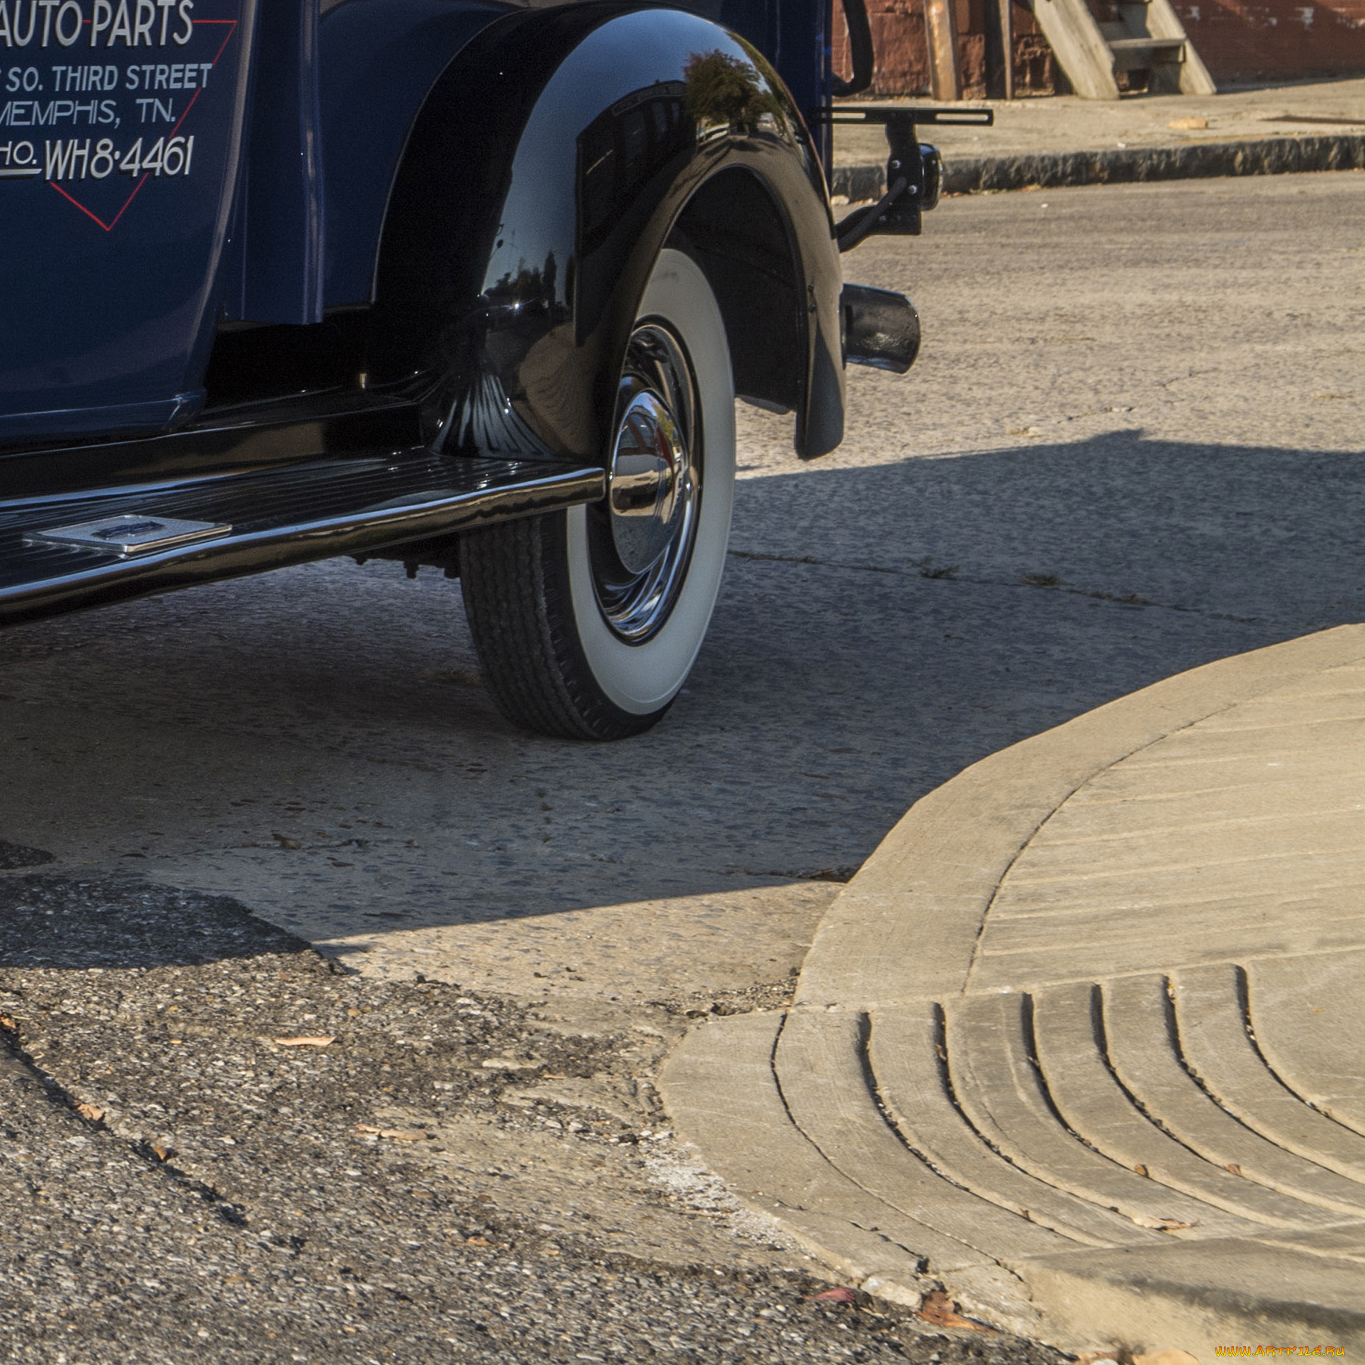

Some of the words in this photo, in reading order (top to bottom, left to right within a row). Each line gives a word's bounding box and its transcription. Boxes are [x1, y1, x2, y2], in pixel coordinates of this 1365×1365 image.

[90, 0, 194, 47] PARTS
[6, 67, 43, 92] SO.
[52, 65, 119, 91] THIRD
[125, 63, 213, 90] STREET
[135, 98, 176, 123] TN.
